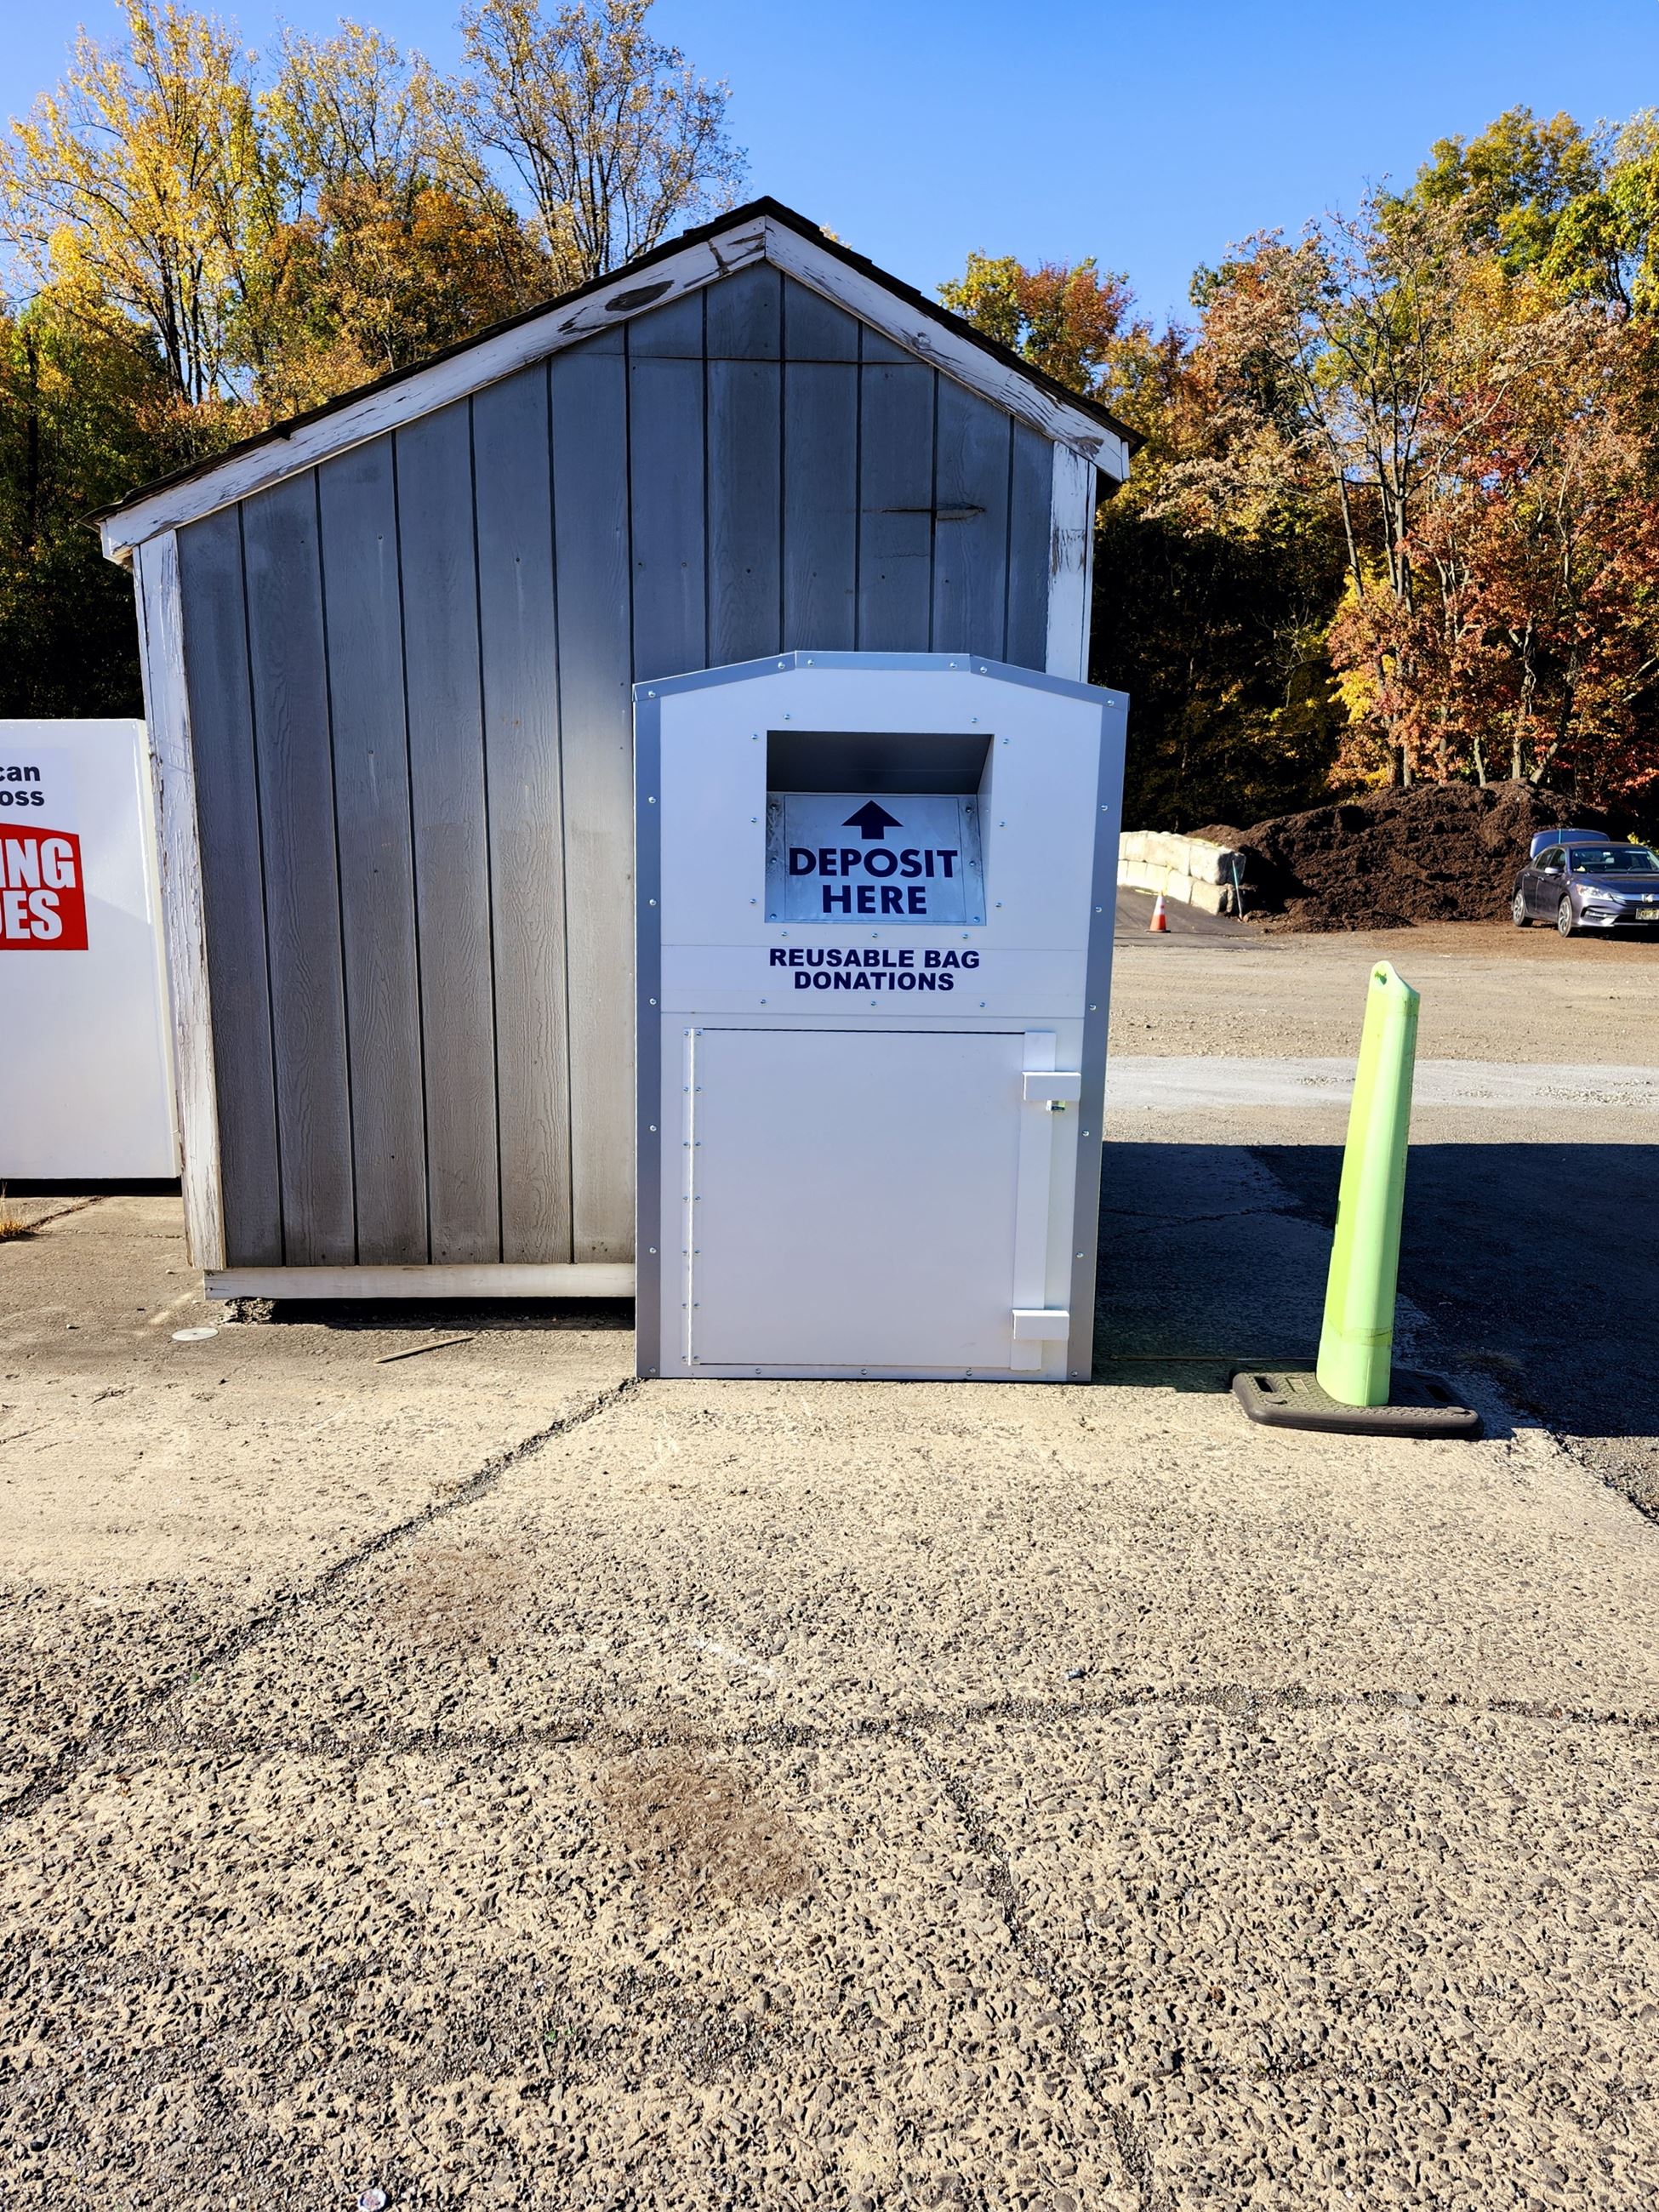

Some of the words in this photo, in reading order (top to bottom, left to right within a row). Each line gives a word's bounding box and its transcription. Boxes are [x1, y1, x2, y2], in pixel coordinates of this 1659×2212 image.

[788, 847, 959, 878] DEPOSIT
[0, 890, 63, 940] ES
[822, 885, 927, 915] HERE
[769, 948, 915, 968] REUSABLE
[924, 950, 980, 969] BAG
[794, 972, 955, 991] DONATIONS
